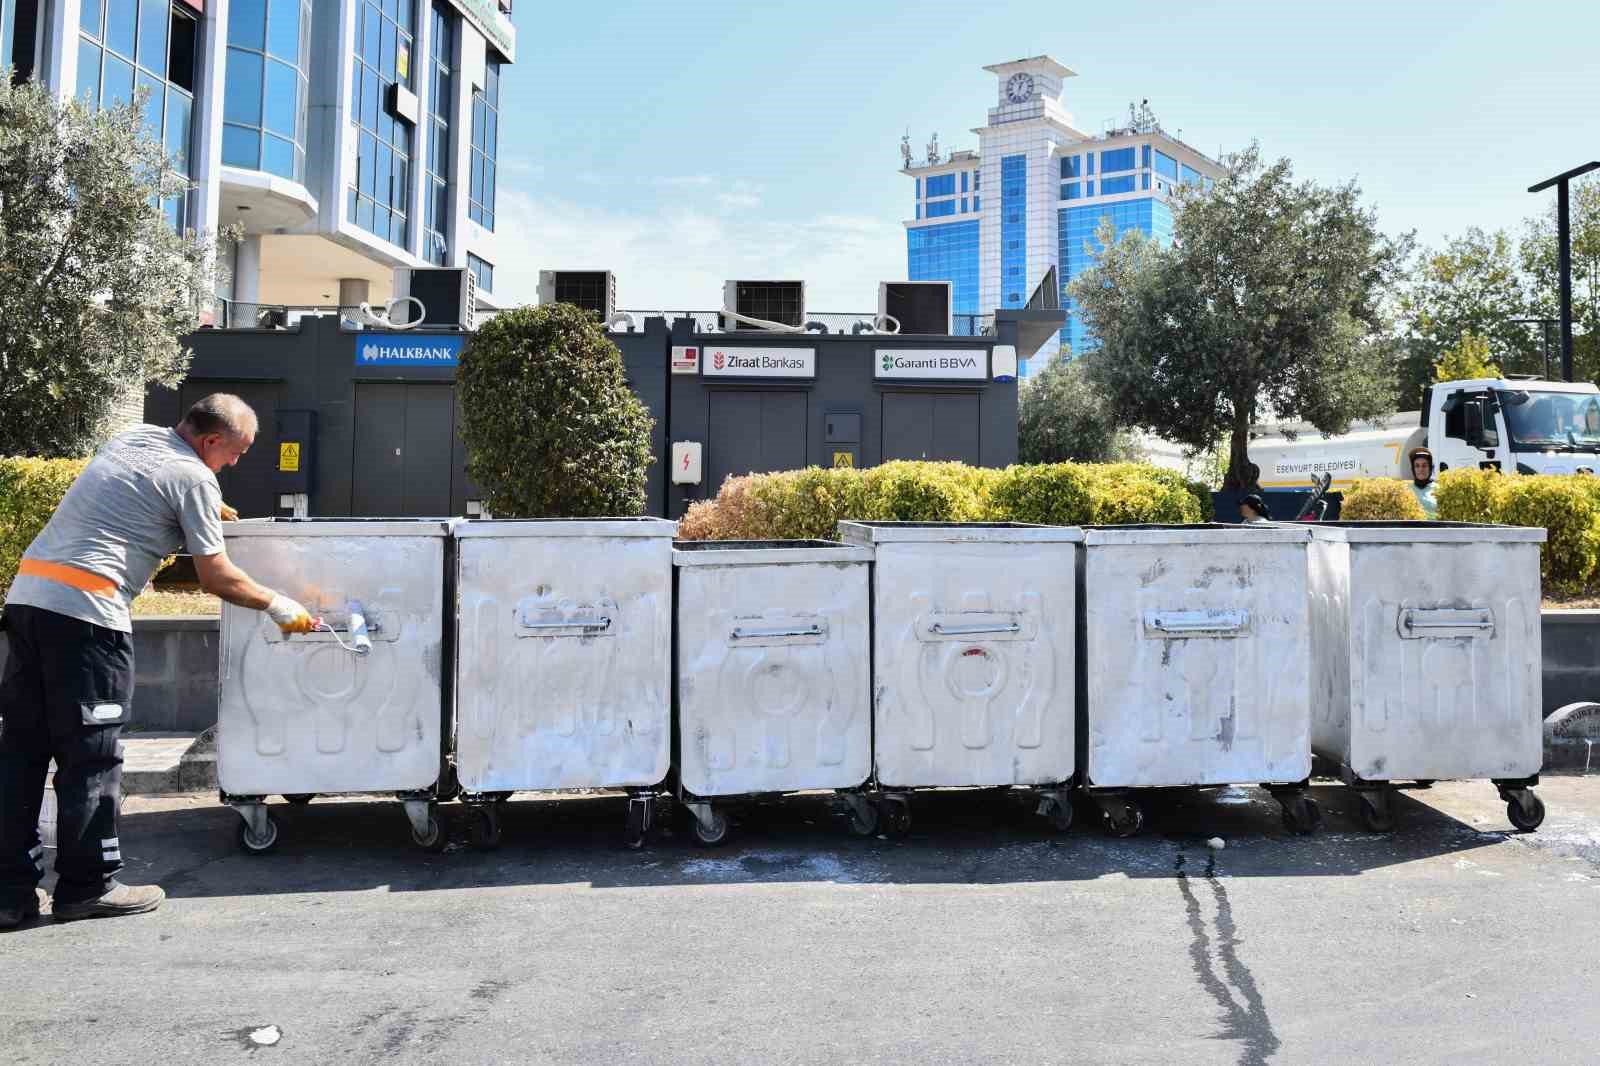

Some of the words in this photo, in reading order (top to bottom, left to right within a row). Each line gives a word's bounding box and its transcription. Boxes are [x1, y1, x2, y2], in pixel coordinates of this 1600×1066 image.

[380, 347, 452, 359] HALKBANK
[728, 356, 760, 368] Ziraat
[762, 357, 804, 368] Bankası
[895, 358, 937, 369] Garanti
[940, 358, 976, 369] BBVA
[1276, 463, 1312, 473] ESENYURT
